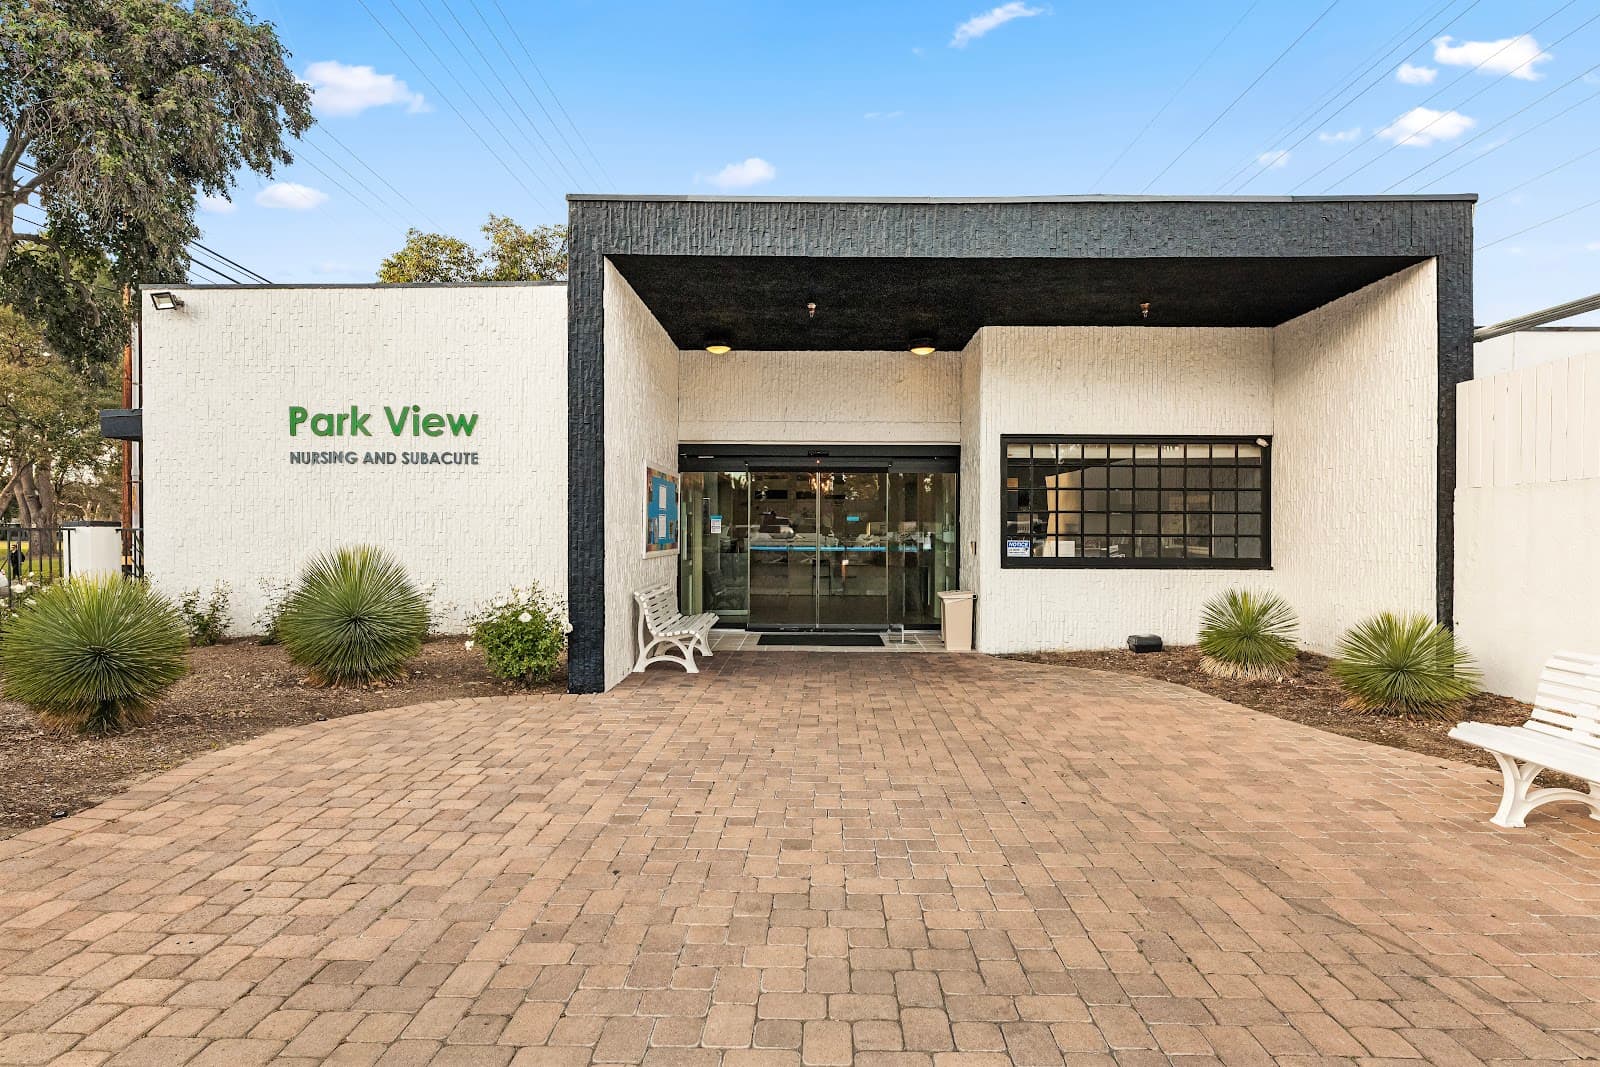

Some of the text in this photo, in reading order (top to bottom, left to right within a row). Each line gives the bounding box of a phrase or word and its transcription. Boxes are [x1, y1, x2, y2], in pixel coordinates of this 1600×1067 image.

[289, 404, 479, 437] Park View
[289, 451, 479, 465] NURSING AND SUBACUTE
